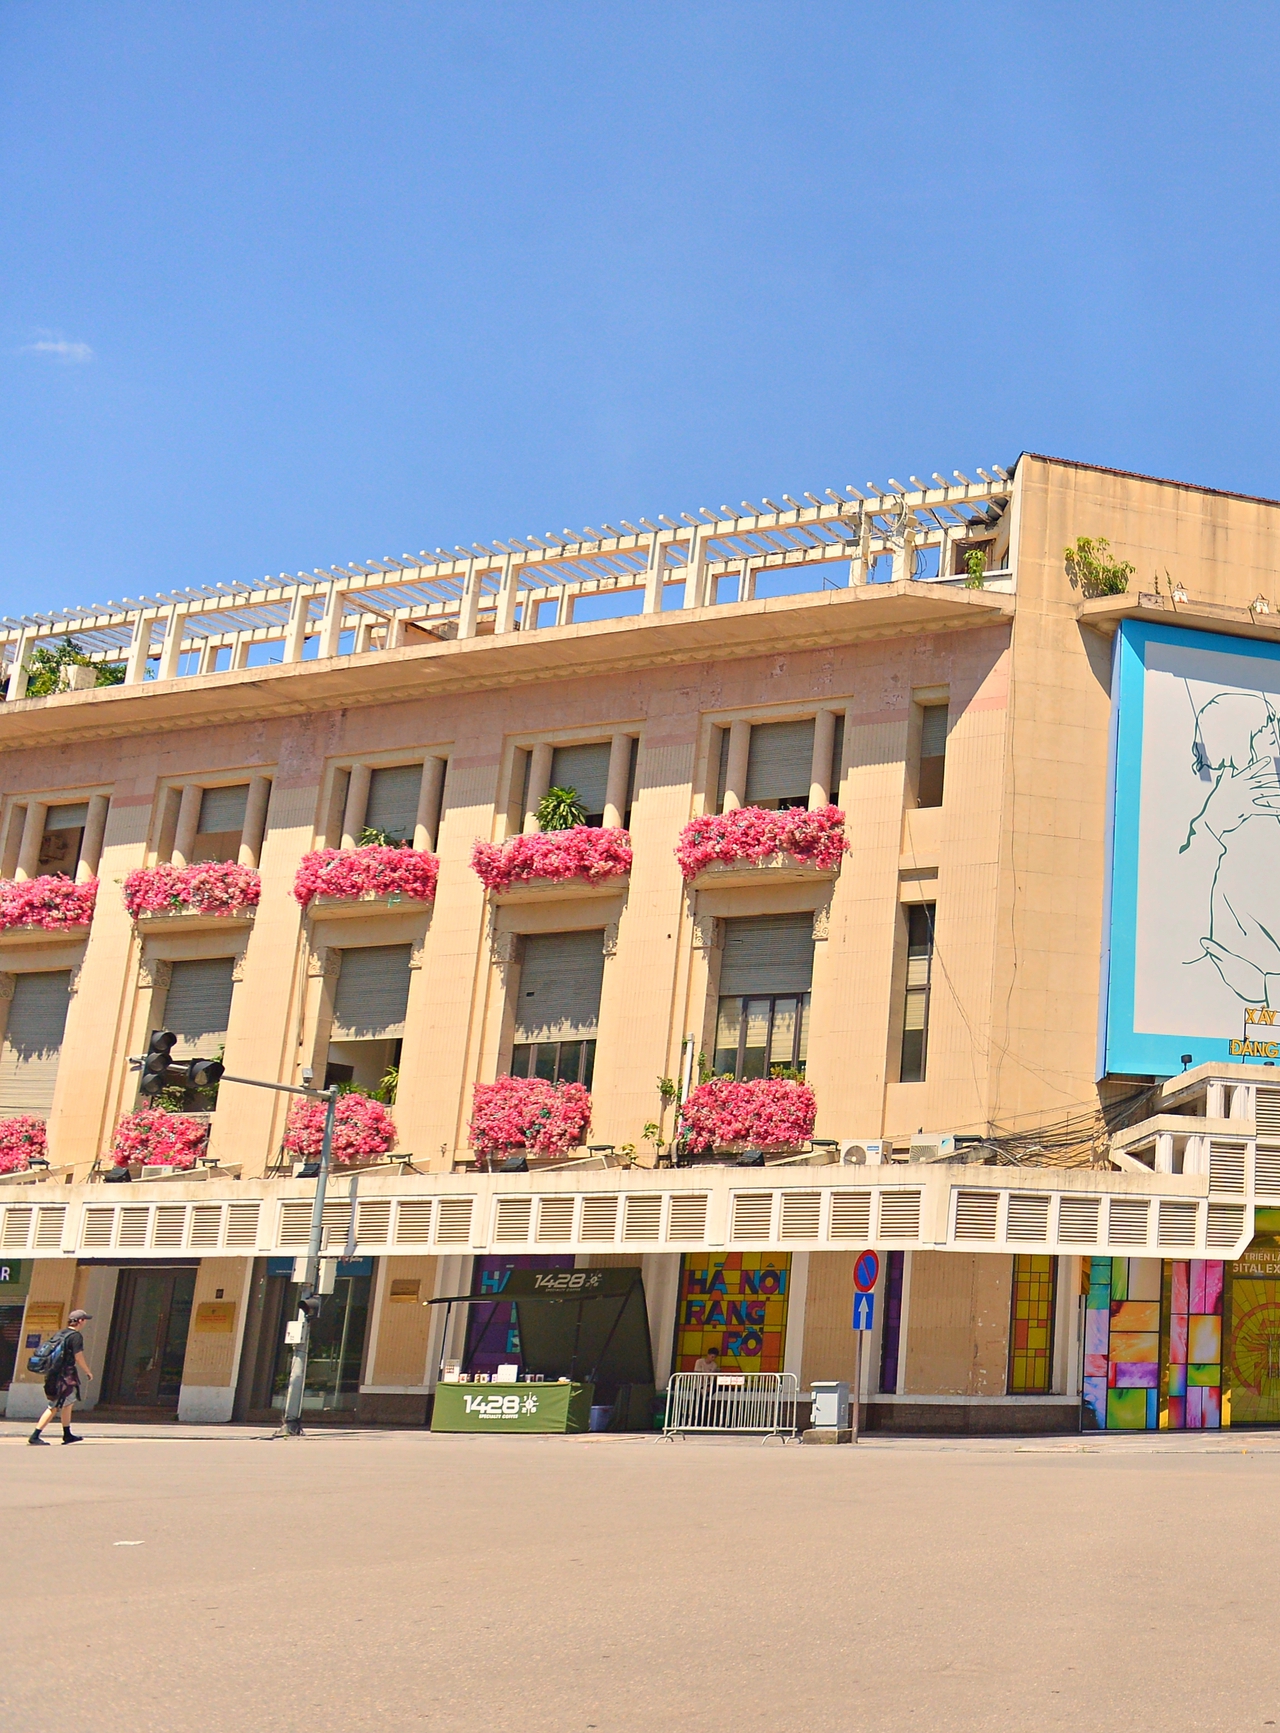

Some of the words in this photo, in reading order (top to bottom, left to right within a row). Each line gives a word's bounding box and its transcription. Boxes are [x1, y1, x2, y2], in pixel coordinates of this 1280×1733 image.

[1245, 1006, 1277, 1025] XÂY
[1230, 1036, 1279, 1058] ĐÀNG
[534, 1272, 586, 1289] 1428
[688, 1262, 728, 1294] HÀ
[739, 1262, 787, 1301] NỘI
[685, 1300, 767, 1329] RẠNG
[463, 1395, 520, 1414] 1428
